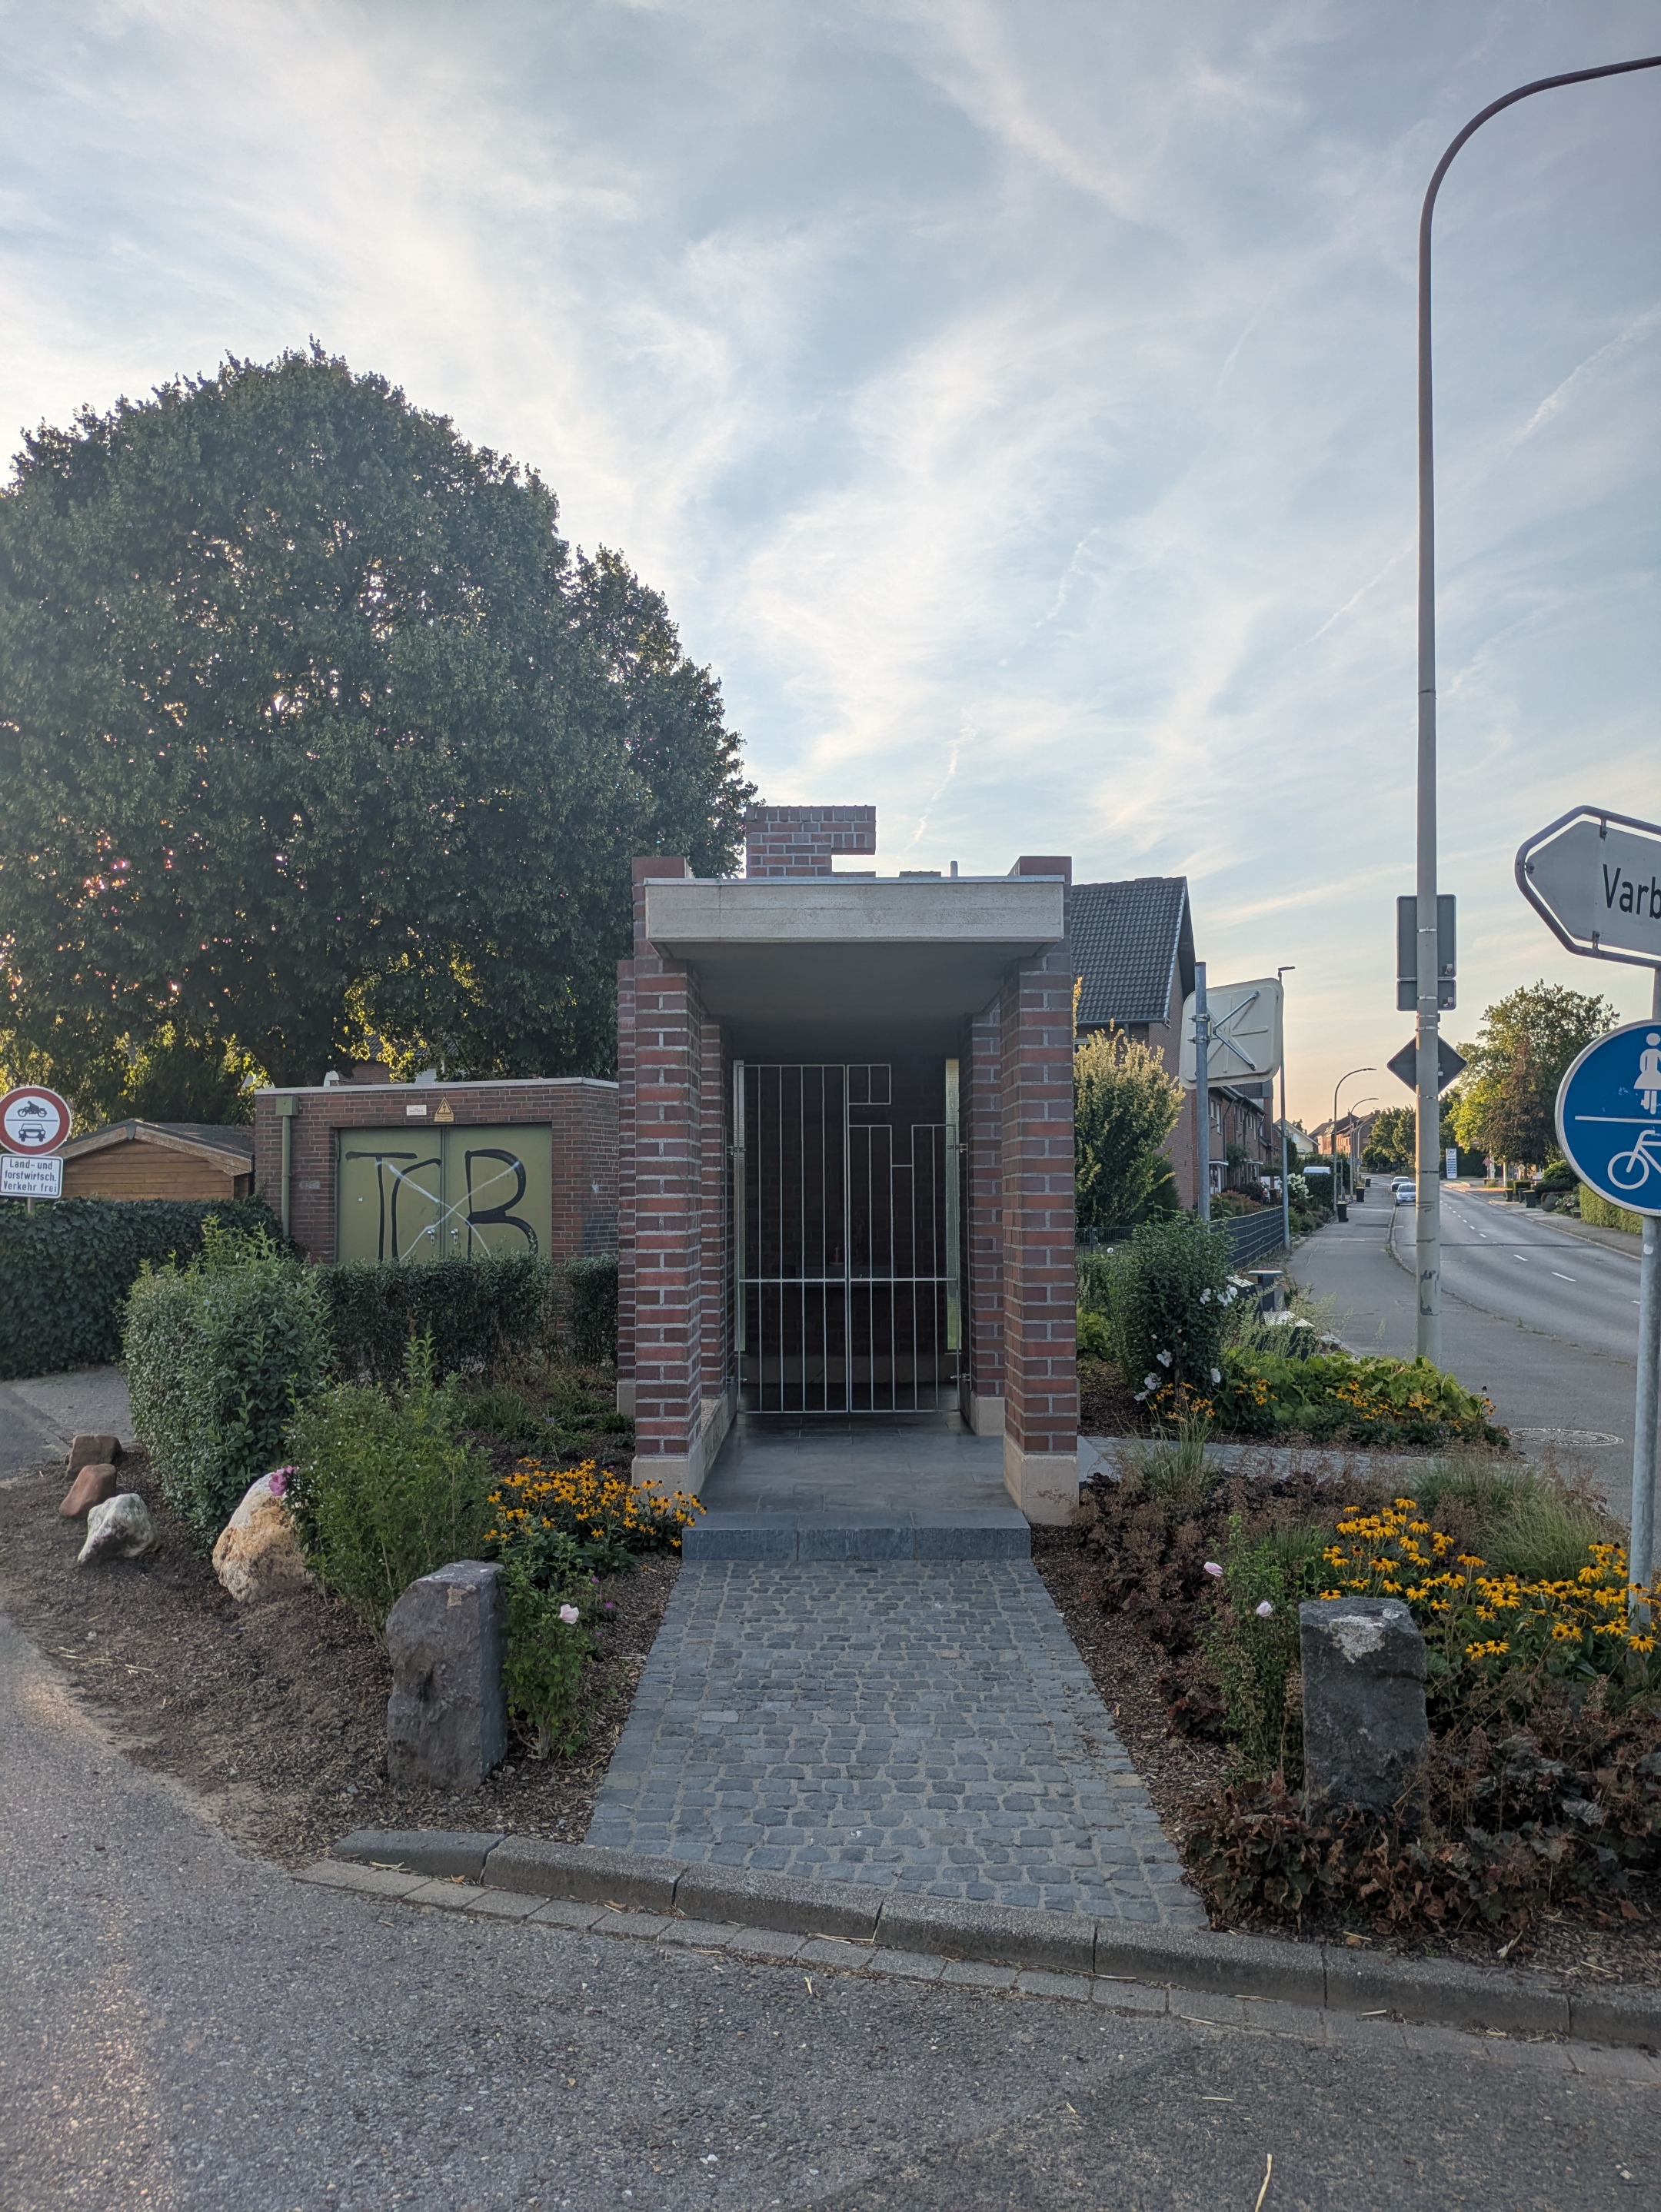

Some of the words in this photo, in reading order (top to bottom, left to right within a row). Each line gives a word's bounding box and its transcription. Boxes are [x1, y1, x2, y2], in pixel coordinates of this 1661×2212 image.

[9, 1158, 35, 1169] Land-
[37, 1161, 53, 1170] und
[5, 1169, 57, 1182] forstwirtsch.
[3, 1180, 37, 1192] Verkehr
[41, 1183, 57, 1193] frei
